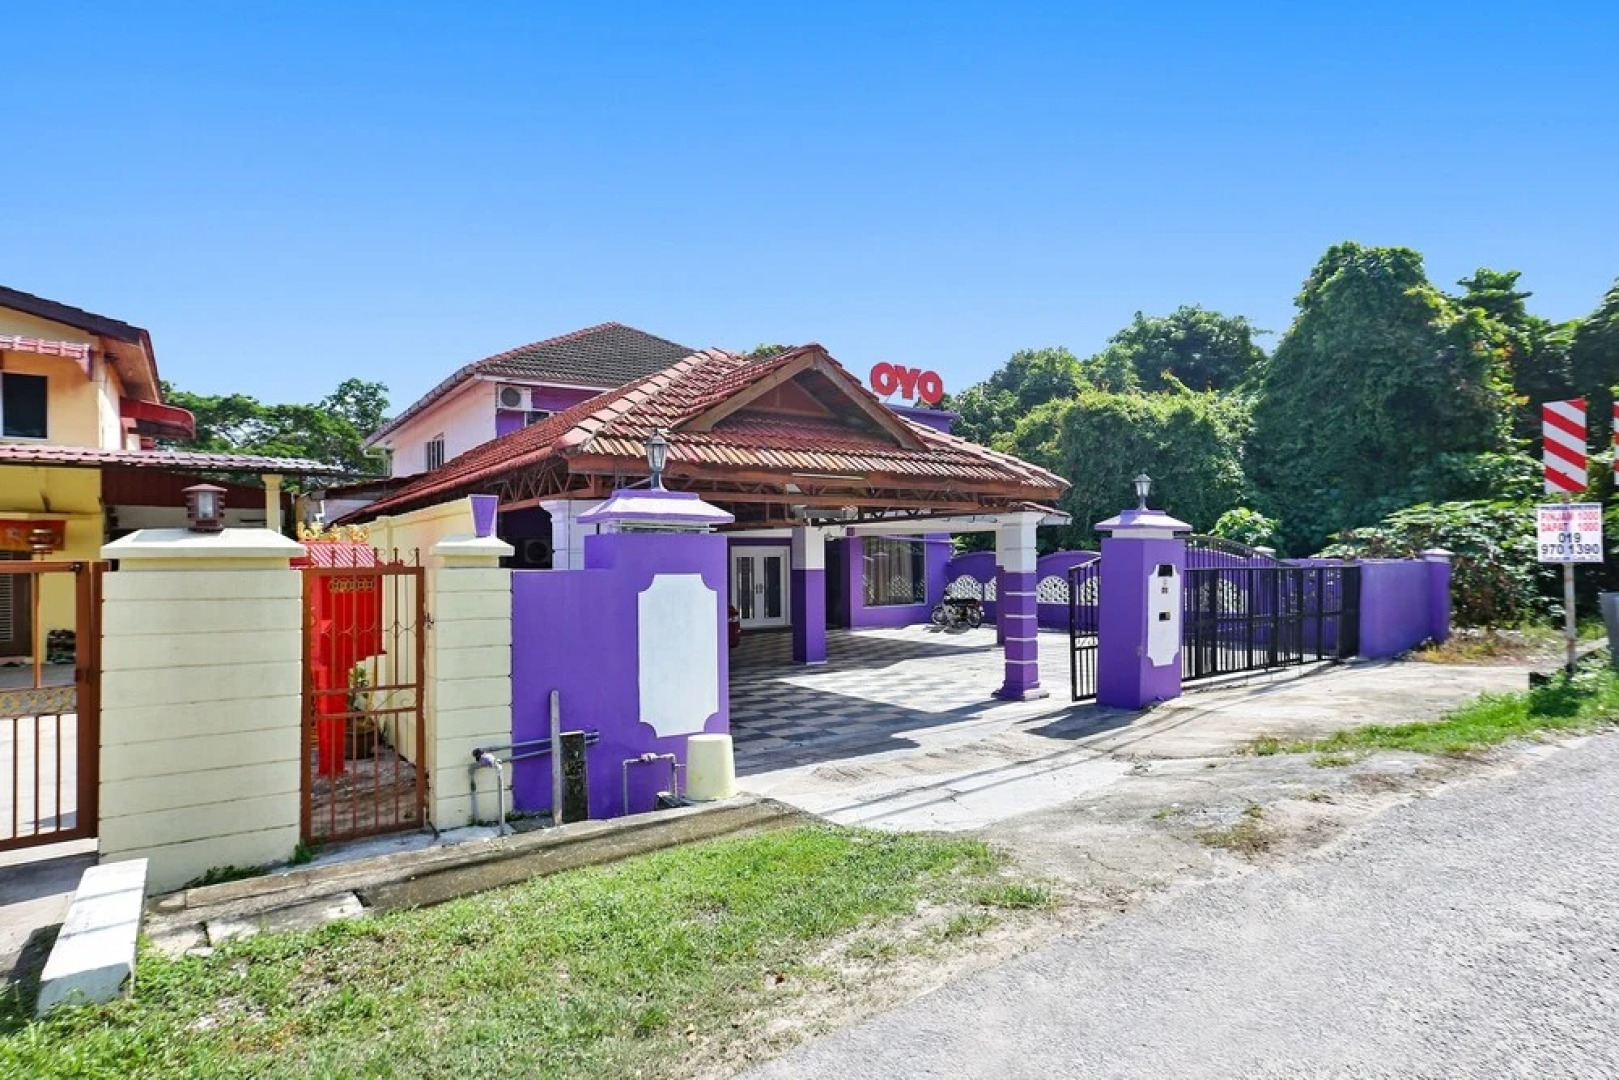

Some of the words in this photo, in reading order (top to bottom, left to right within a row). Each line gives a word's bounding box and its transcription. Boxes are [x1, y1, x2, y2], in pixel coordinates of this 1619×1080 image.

[870, 362, 943, 404] OYO
[1558, 532, 1581, 543] 019
[1541, 543, 1565, 555] 970
[1568, 543, 1600, 555] 1390
